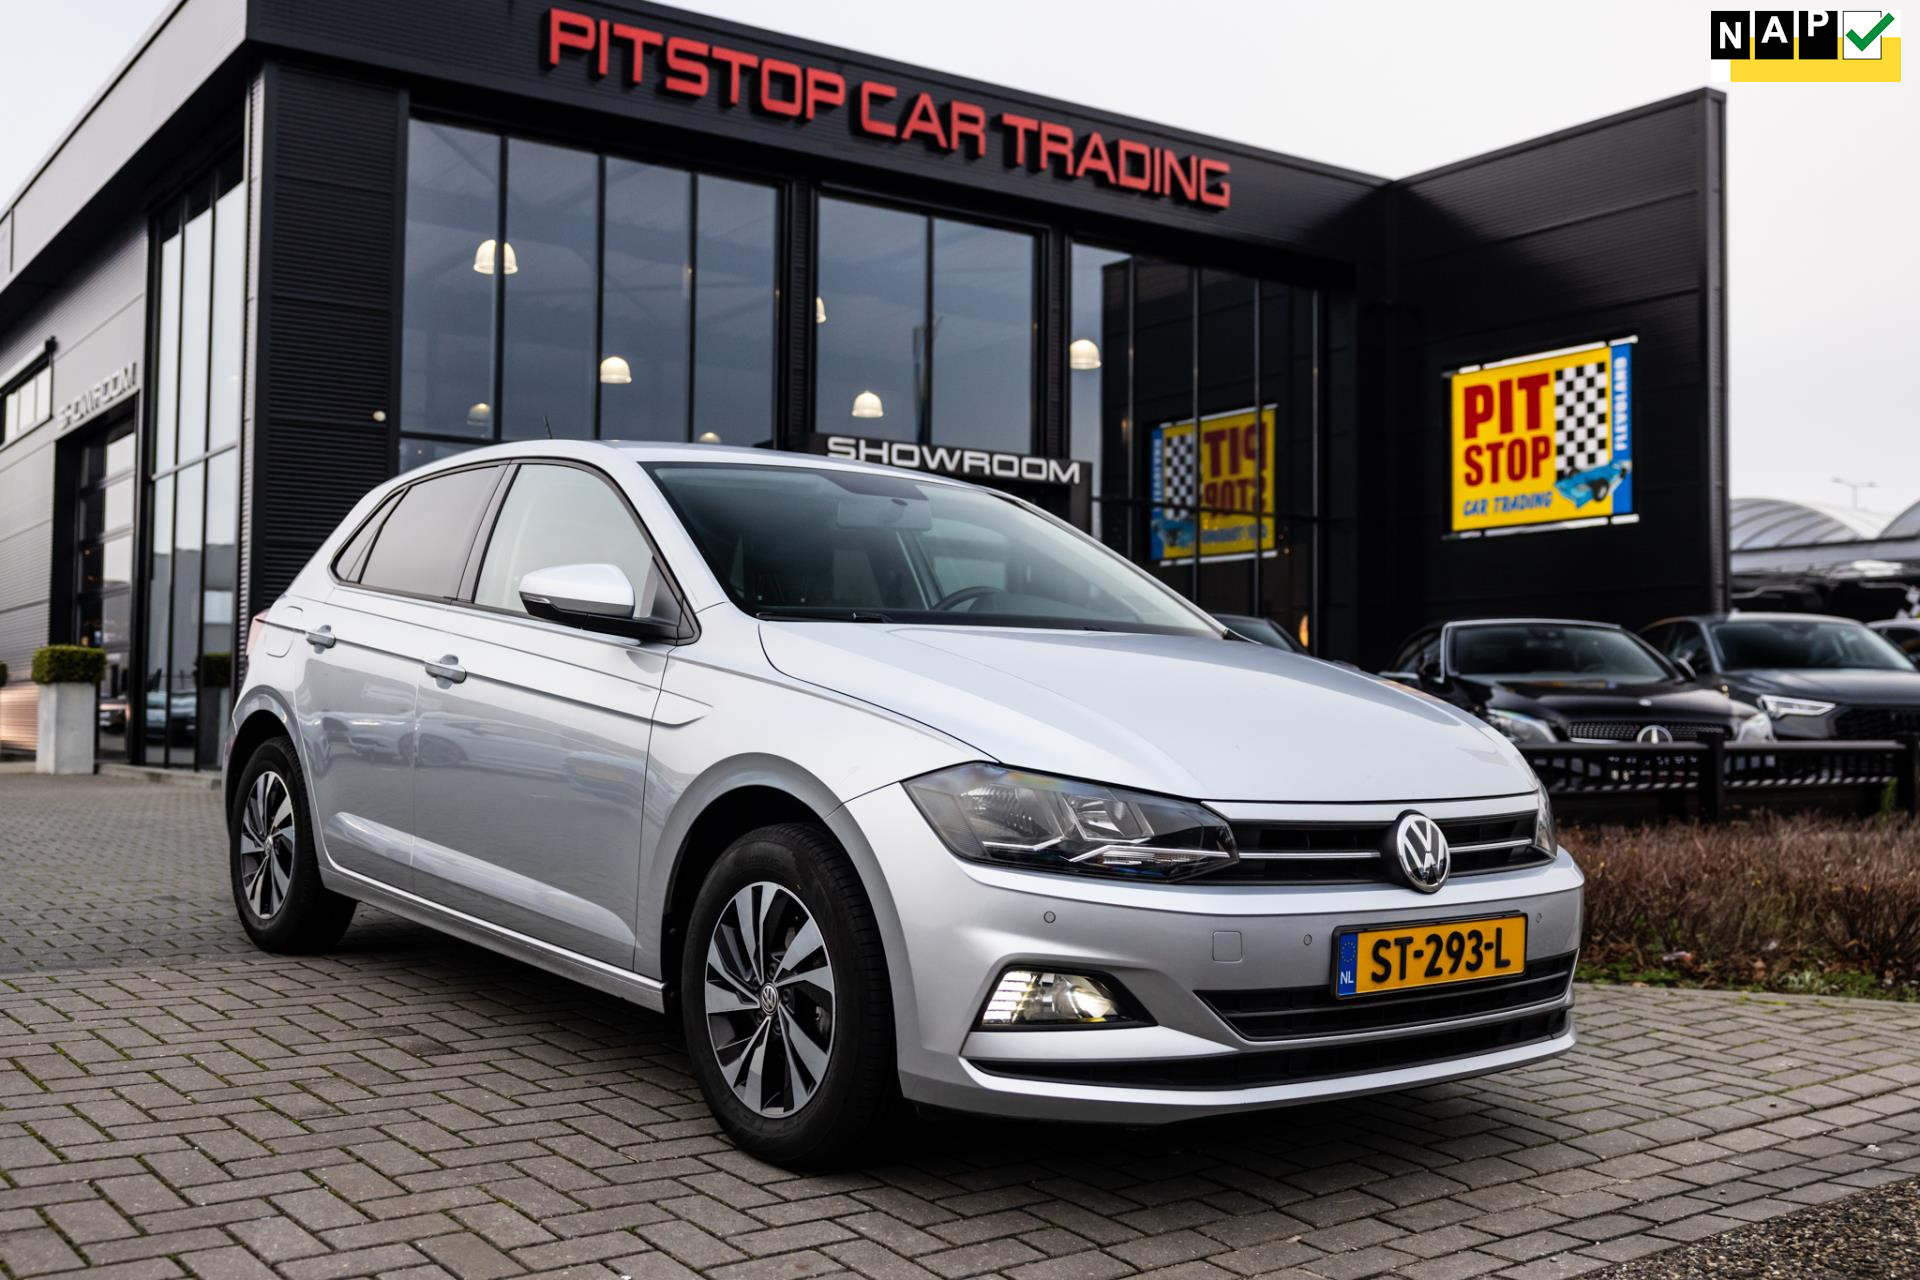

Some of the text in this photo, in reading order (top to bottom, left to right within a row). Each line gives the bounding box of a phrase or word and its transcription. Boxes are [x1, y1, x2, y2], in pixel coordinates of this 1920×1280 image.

[548, 8, 1231, 209] PITSTOP CAR TRADING
[1463, 372, 1550, 440] PIT
[827, 436, 1080, 484] SHOWROOM
[1464, 435, 1551, 487] STOP
[1463, 491, 1553, 517] CAR TRADING
[1340, 971, 1355, 985] NL
[1371, 927, 1511, 984] ST-293-L
